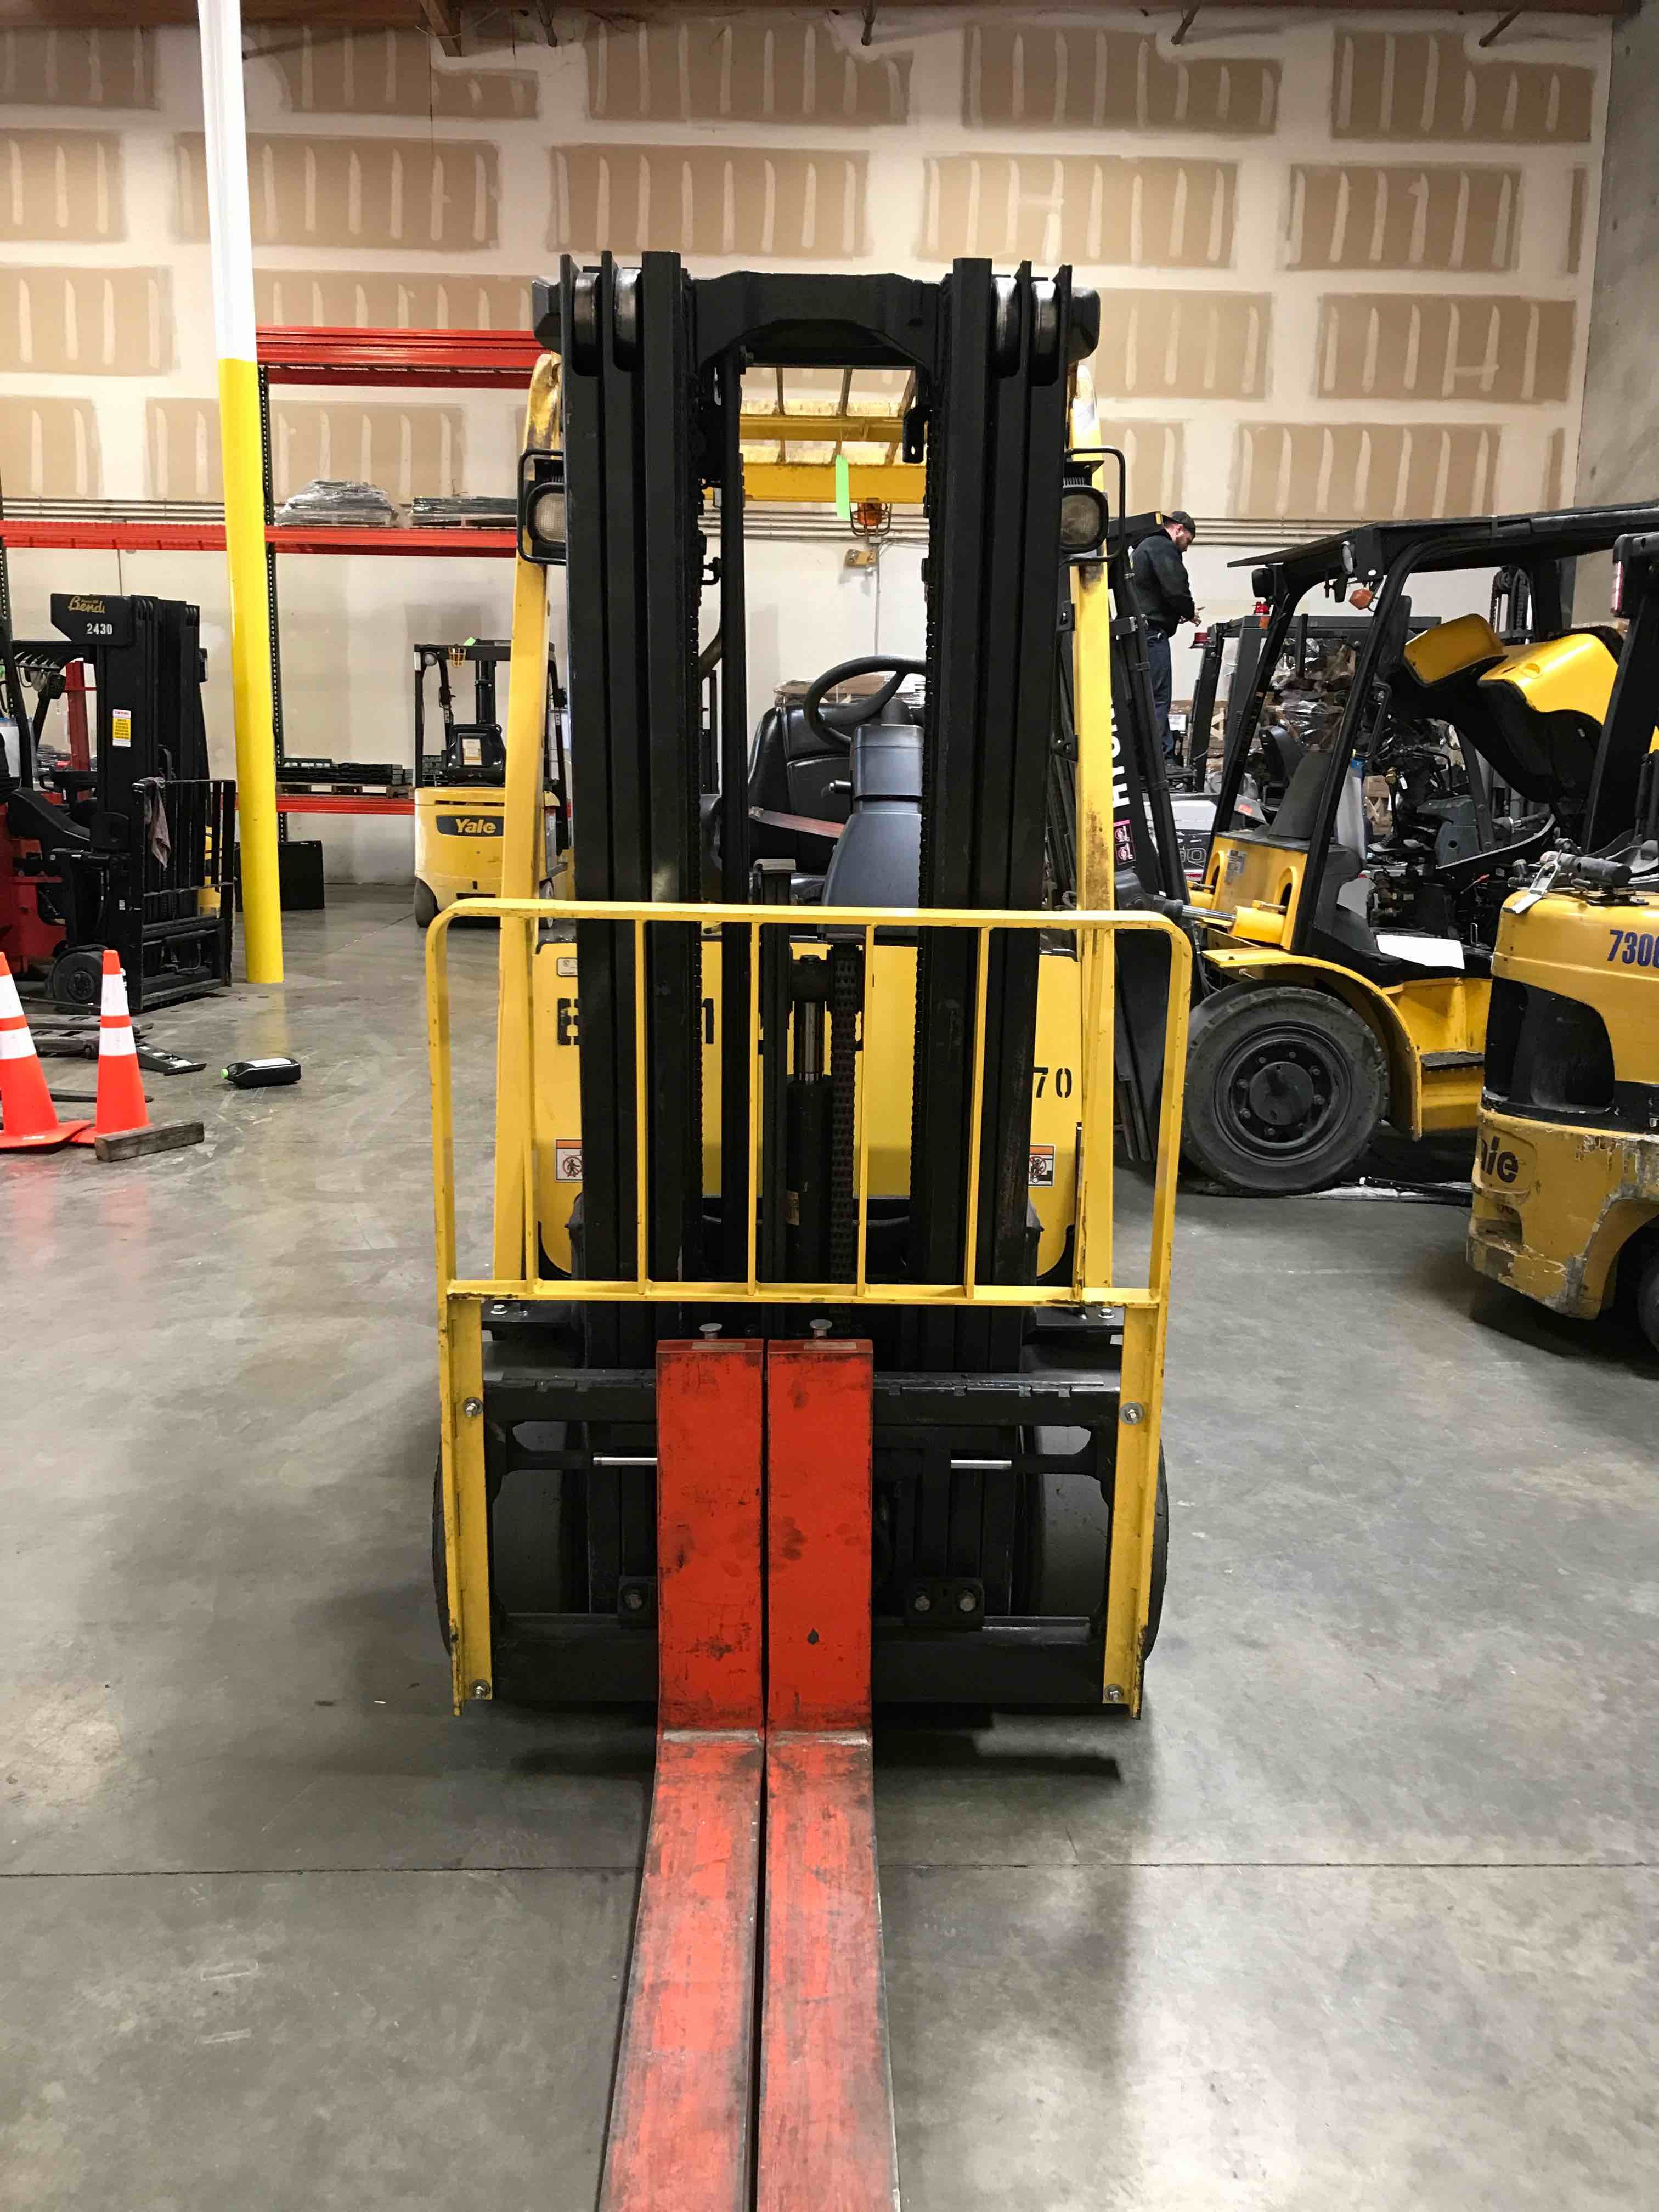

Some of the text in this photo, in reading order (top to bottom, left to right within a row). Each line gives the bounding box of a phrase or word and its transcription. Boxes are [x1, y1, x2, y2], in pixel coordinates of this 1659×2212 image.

[68, 596, 105, 614] Bendi
[86, 623, 112, 635] 2430
[455, 818, 496, 834] Yale
